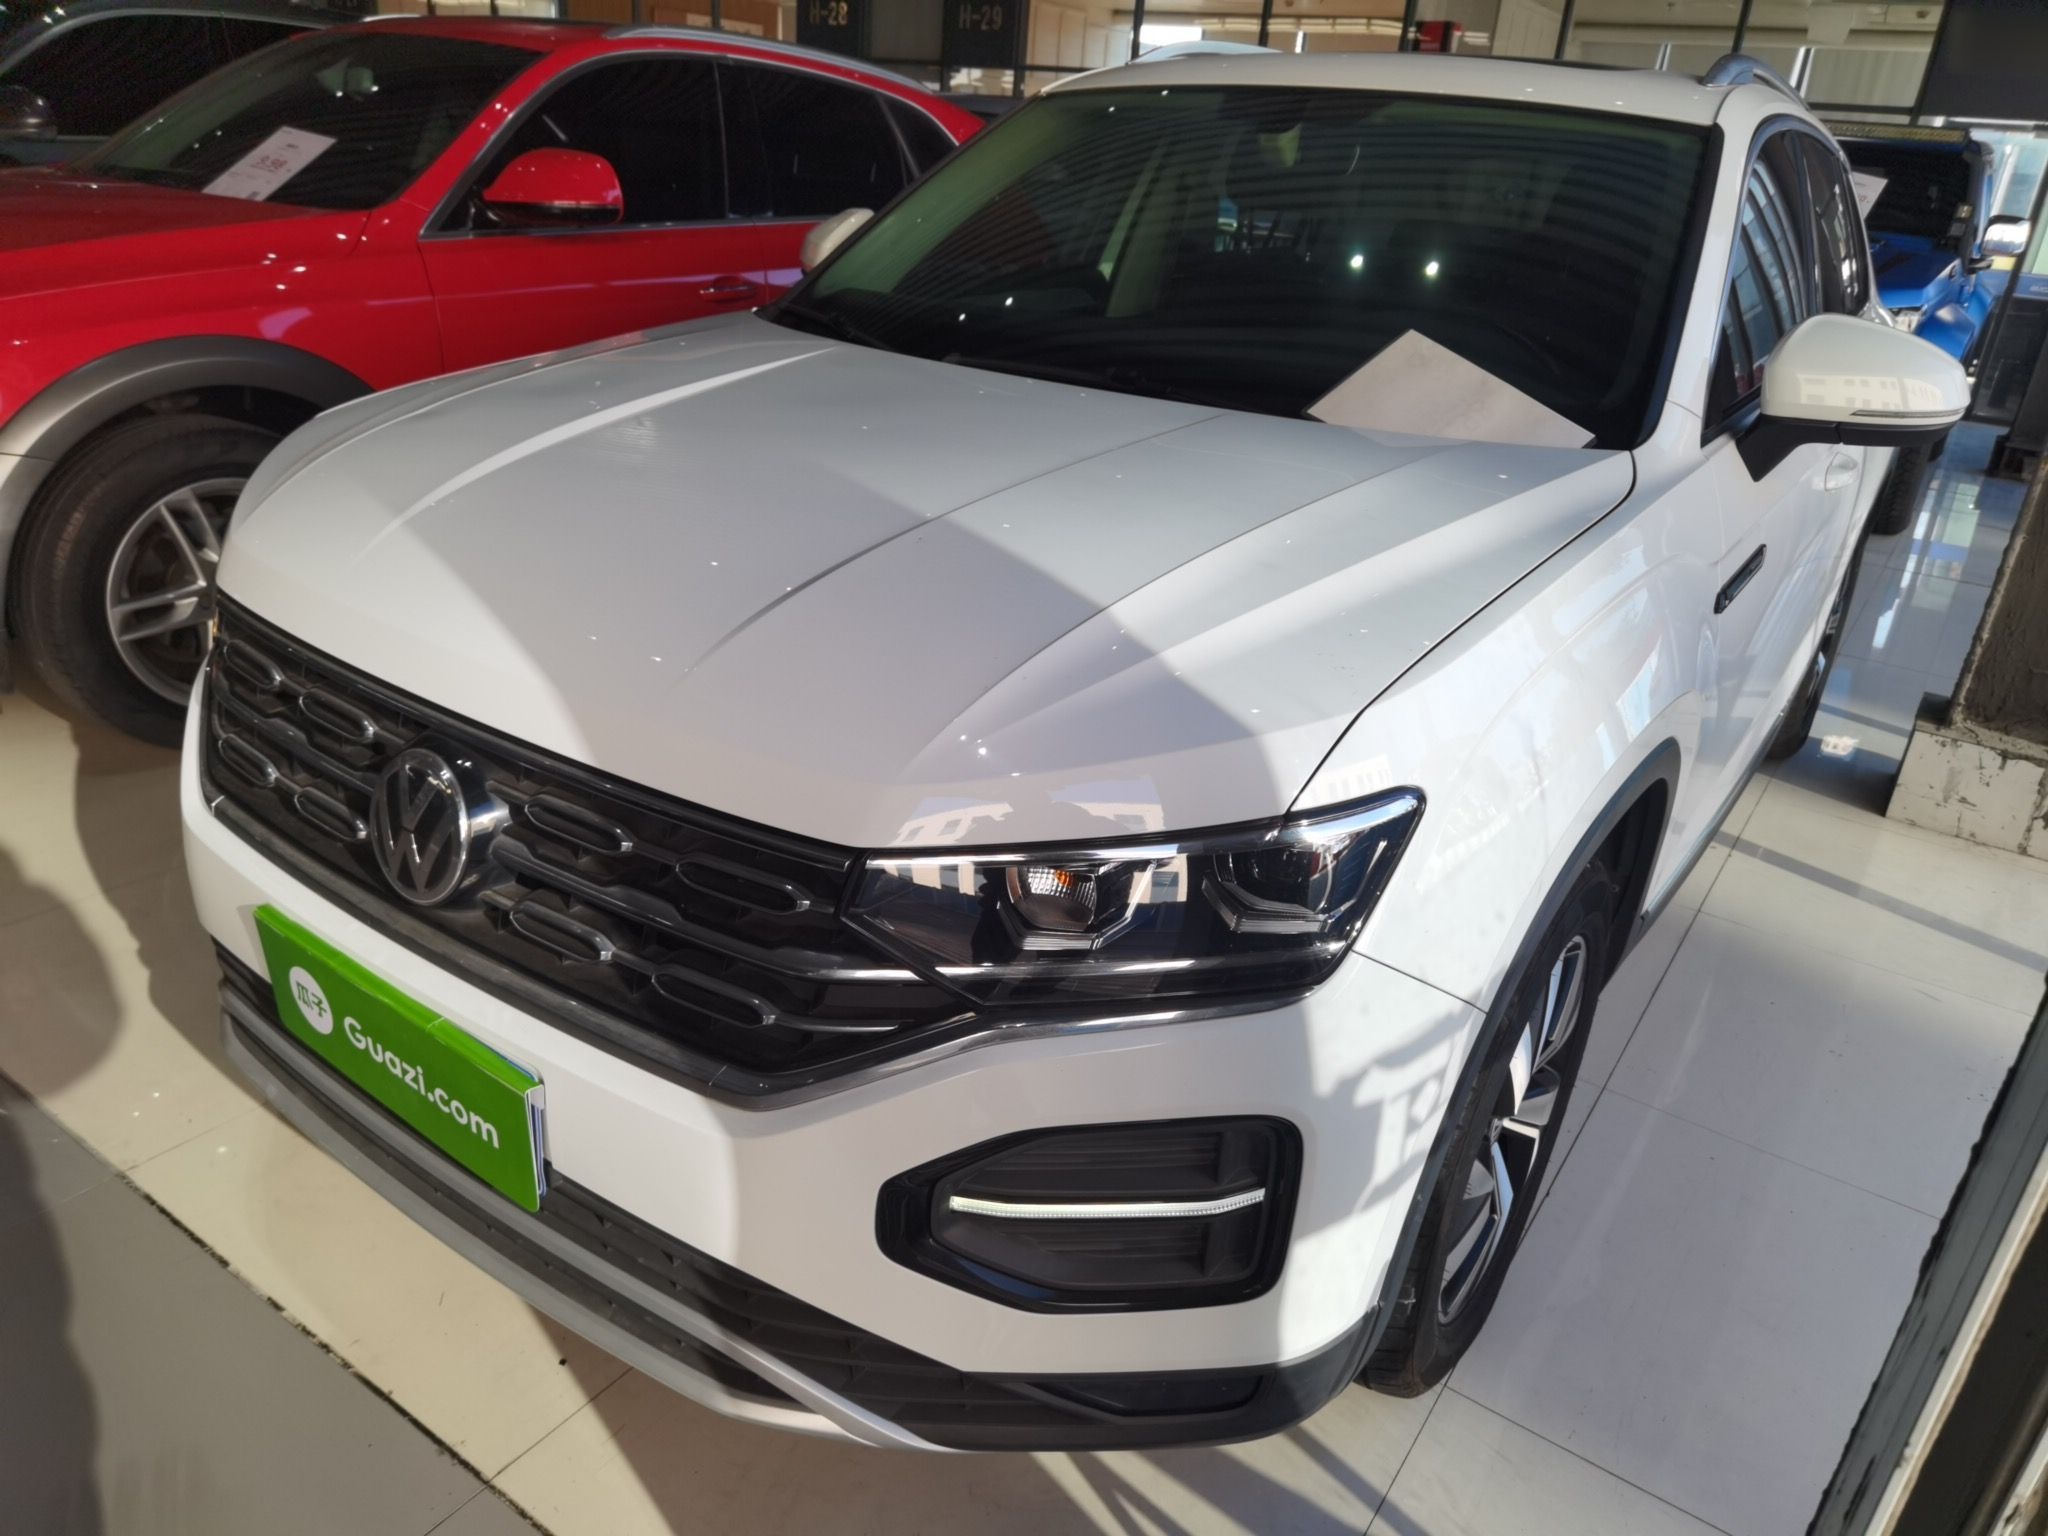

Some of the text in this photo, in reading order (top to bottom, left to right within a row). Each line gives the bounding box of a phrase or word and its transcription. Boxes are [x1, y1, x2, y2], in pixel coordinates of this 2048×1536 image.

[809, 0, 849, 26] H-28
[959, 4, 1002, 31] H-29
[295, 980, 328, 1018] 瓜子
[343, 1016, 500, 1149] Guazi.com
